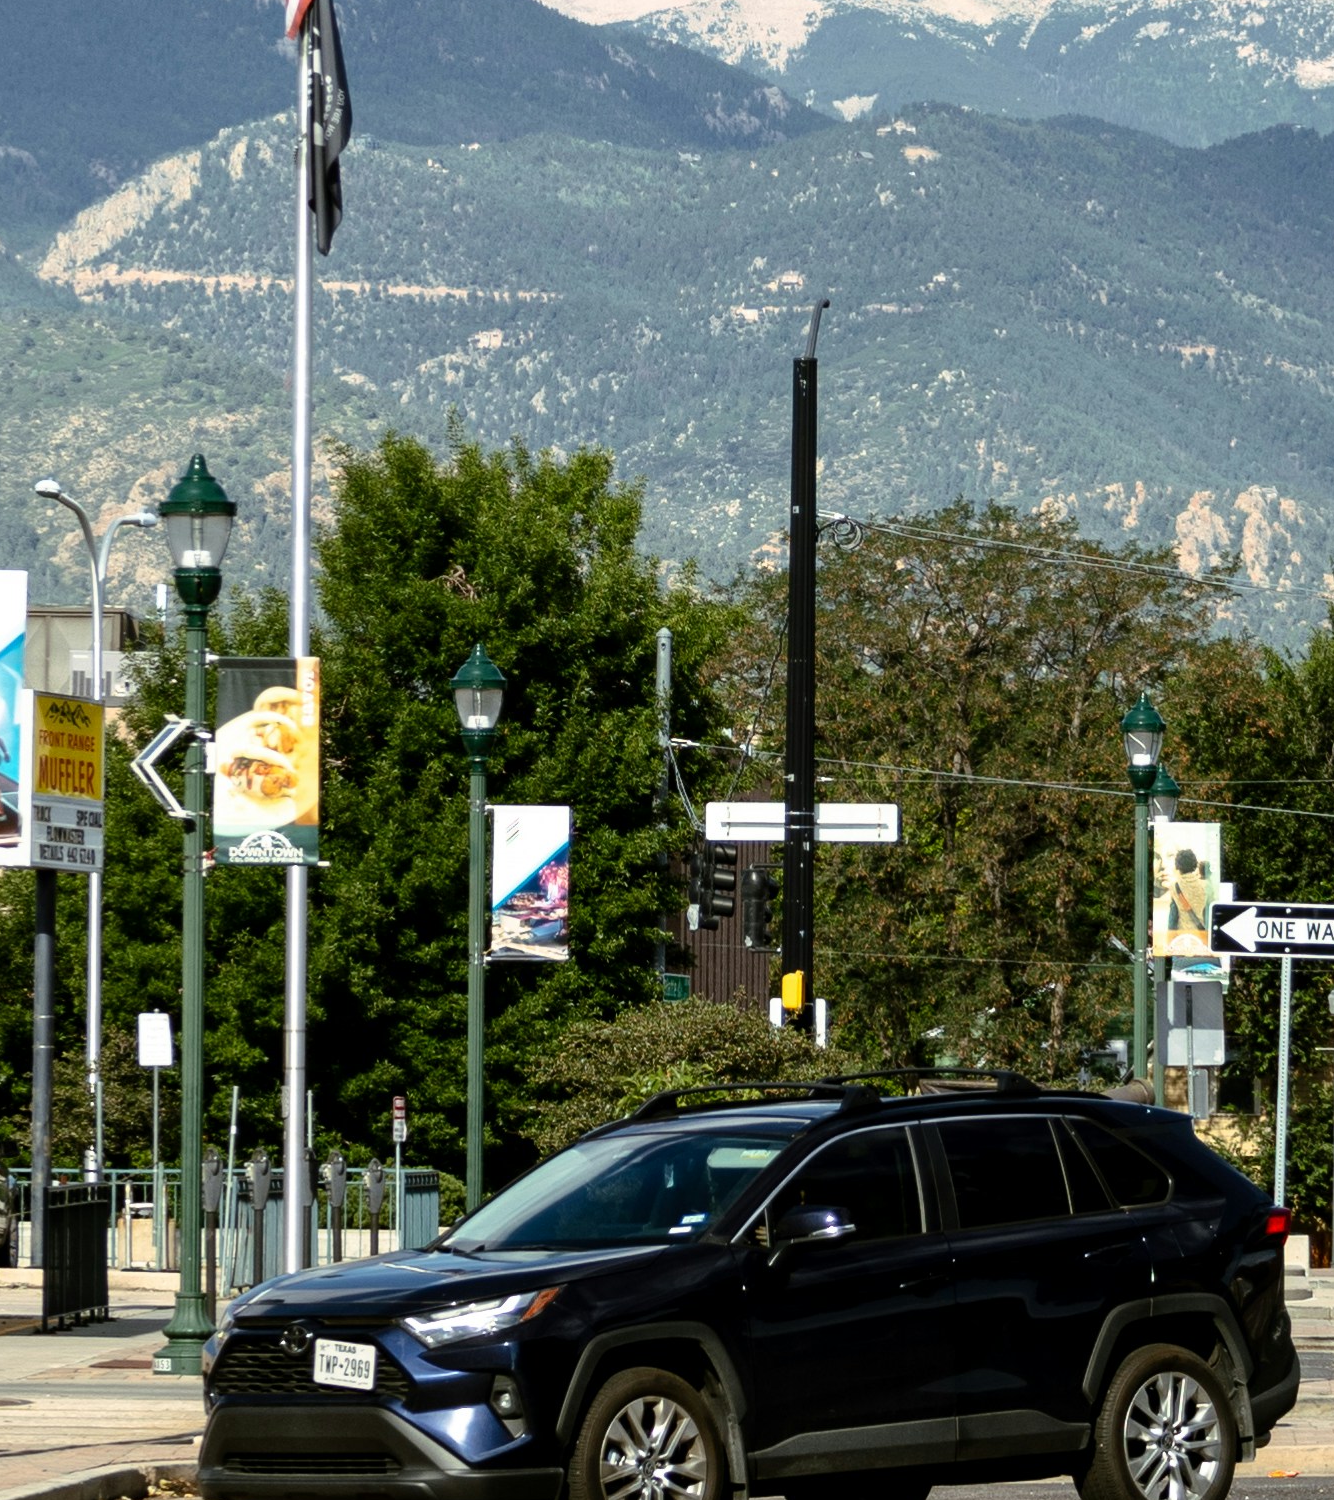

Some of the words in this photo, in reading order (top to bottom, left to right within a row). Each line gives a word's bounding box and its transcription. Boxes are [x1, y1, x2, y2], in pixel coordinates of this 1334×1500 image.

[39, 729, 65, 747] FRONT
[67, 733, 95, 753] RANGE
[38, 755, 95, 795] MUFFLER
[228, 846, 304, 857] DOWNTOWN
[1256, 920, 1296, 940] ONE
[334, 1343, 357, 1354] TEXAS
